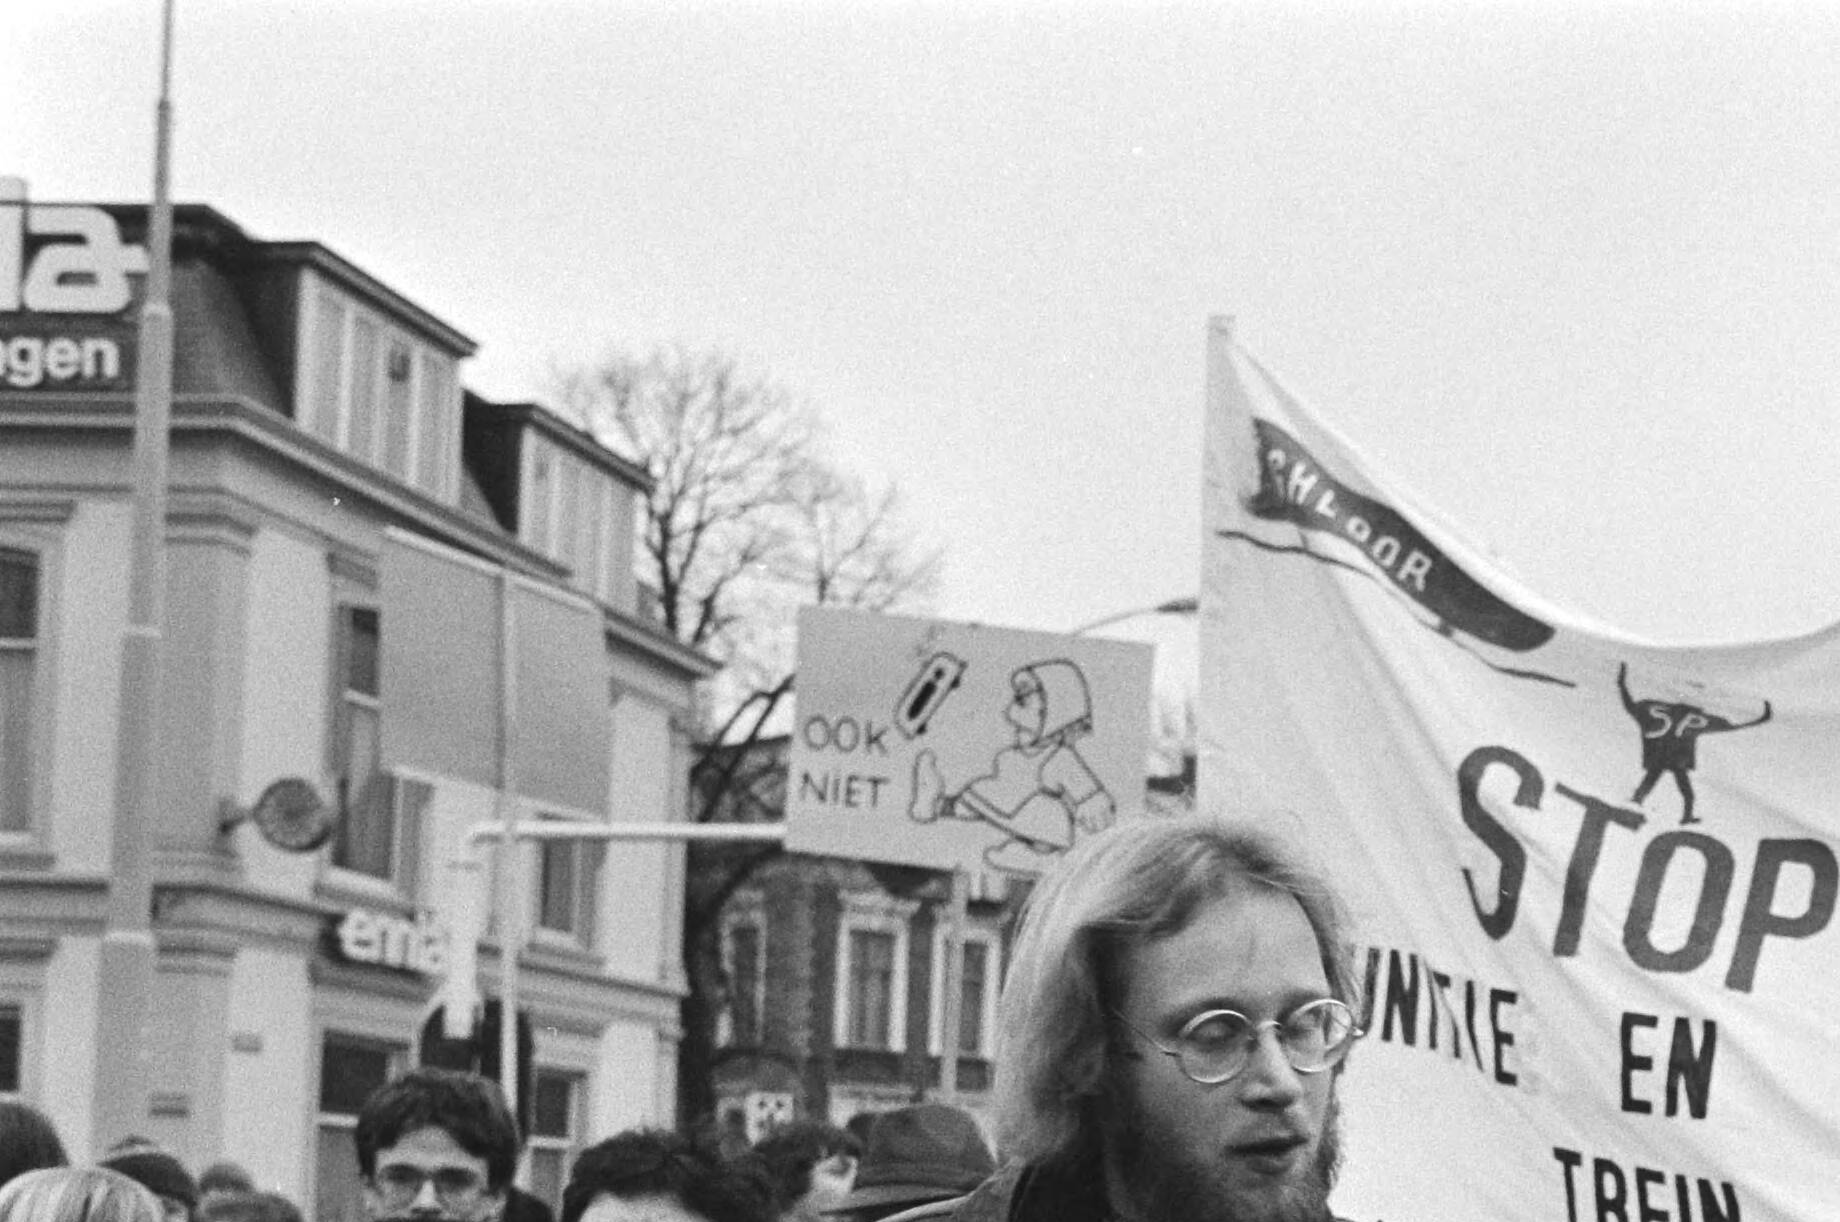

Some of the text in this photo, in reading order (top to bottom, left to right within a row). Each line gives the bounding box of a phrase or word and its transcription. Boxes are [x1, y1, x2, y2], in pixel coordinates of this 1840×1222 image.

[0, 336, 120, 387] gen
[1645, 705, 1709, 740] SP
[1456, 743, 1840, 993] STOP
[1619, 1012, 1718, 1121] EN
